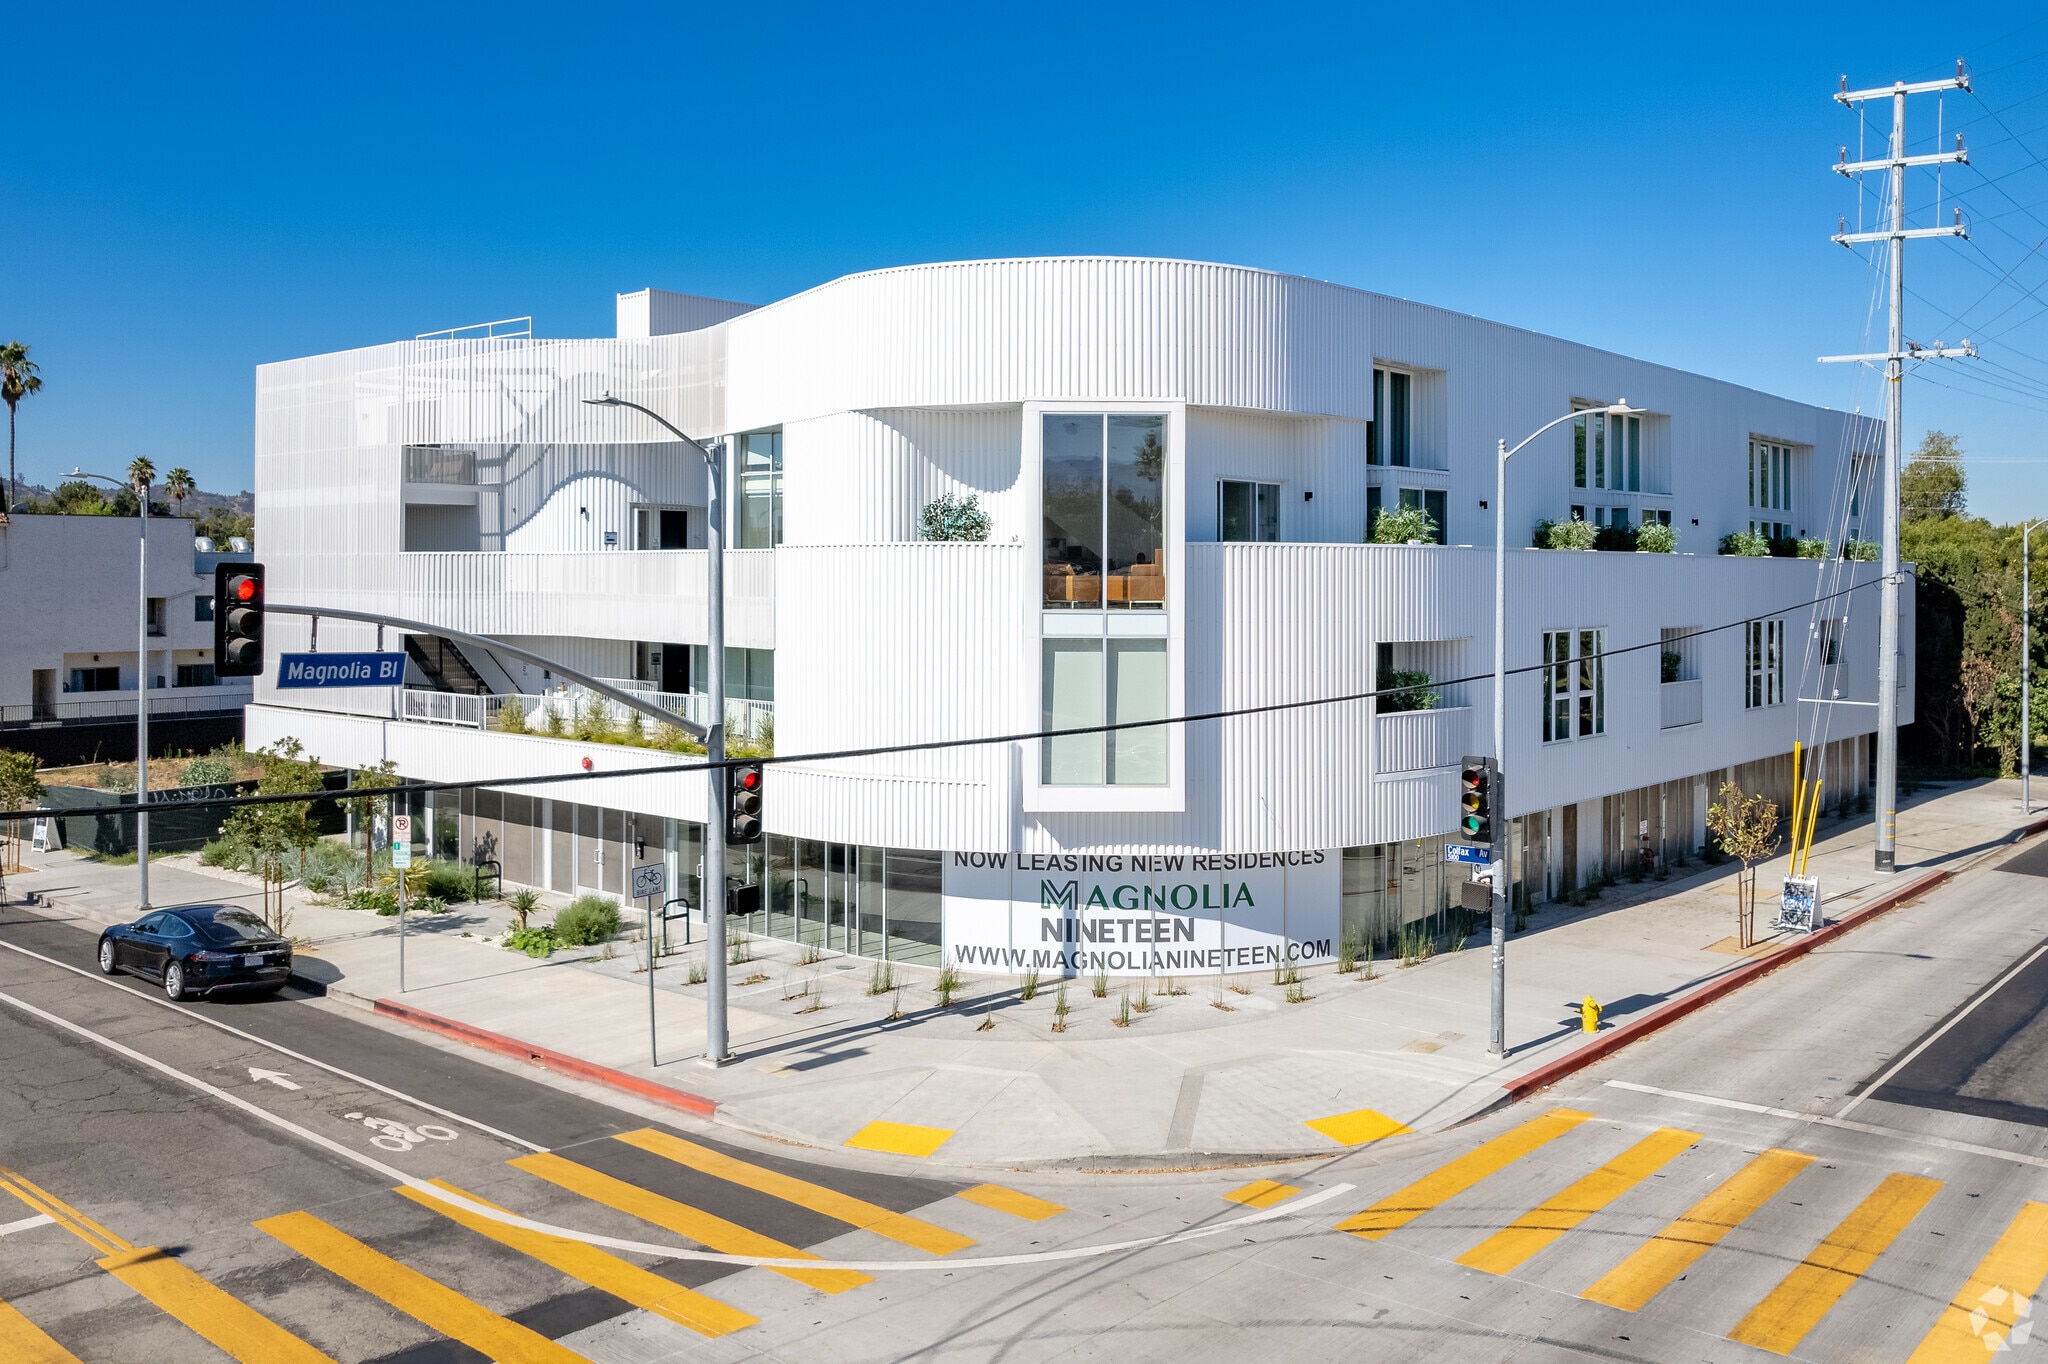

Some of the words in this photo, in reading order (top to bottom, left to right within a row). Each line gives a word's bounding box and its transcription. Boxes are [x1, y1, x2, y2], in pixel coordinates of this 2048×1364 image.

[287, 661, 371, 685] Magnolia
[379, 661, 398, 679] Bl
[954, 851, 1008, 869] NOW
[1017, 853, 1123, 872] LEASING
[1132, 855, 1185, 872] NEW
[1192, 849, 1325, 871] RESIDENCES
[1447, 845, 1470, 857] Colfax
[1478, 849, 1488, 858] Av
[1040, 879, 1255, 911] MAGNOLIA
[1041, 917, 1195, 943] NINETEEN
[955, 938, 1331, 970] WWW.MAGNOLIANINETEEN.COM
